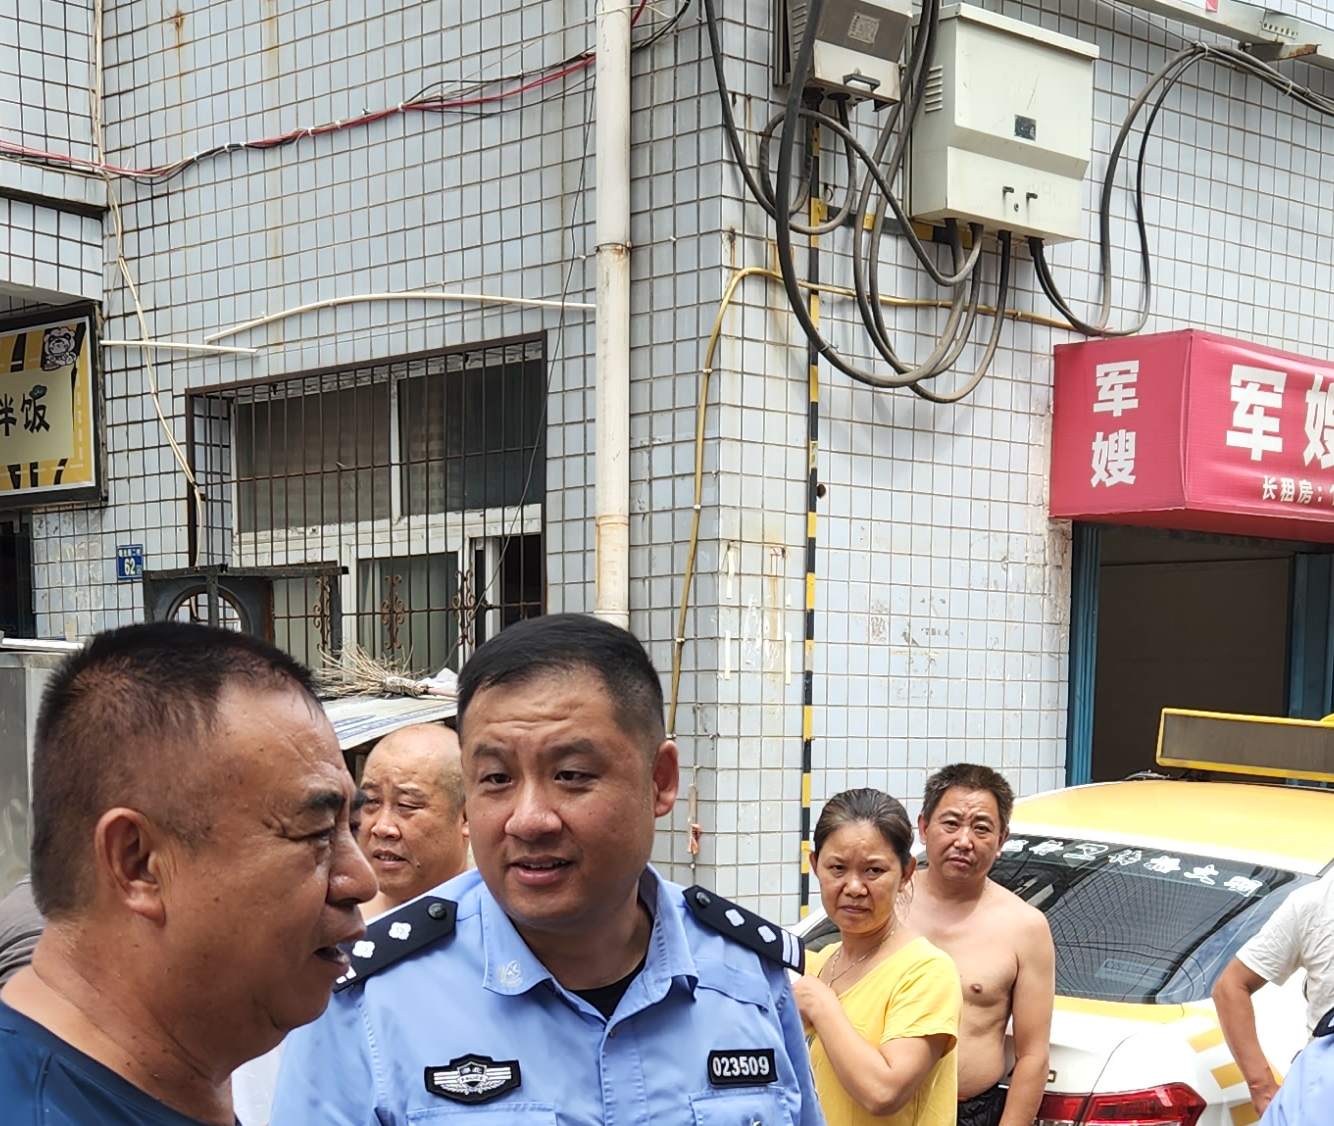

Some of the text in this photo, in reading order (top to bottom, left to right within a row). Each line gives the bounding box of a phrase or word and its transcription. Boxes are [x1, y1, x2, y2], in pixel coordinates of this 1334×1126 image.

[1091, 359, 1140, 488] 军嫂
[124, 557, 136, 576] 62
[712, 1055, 770, 1077] 023509
